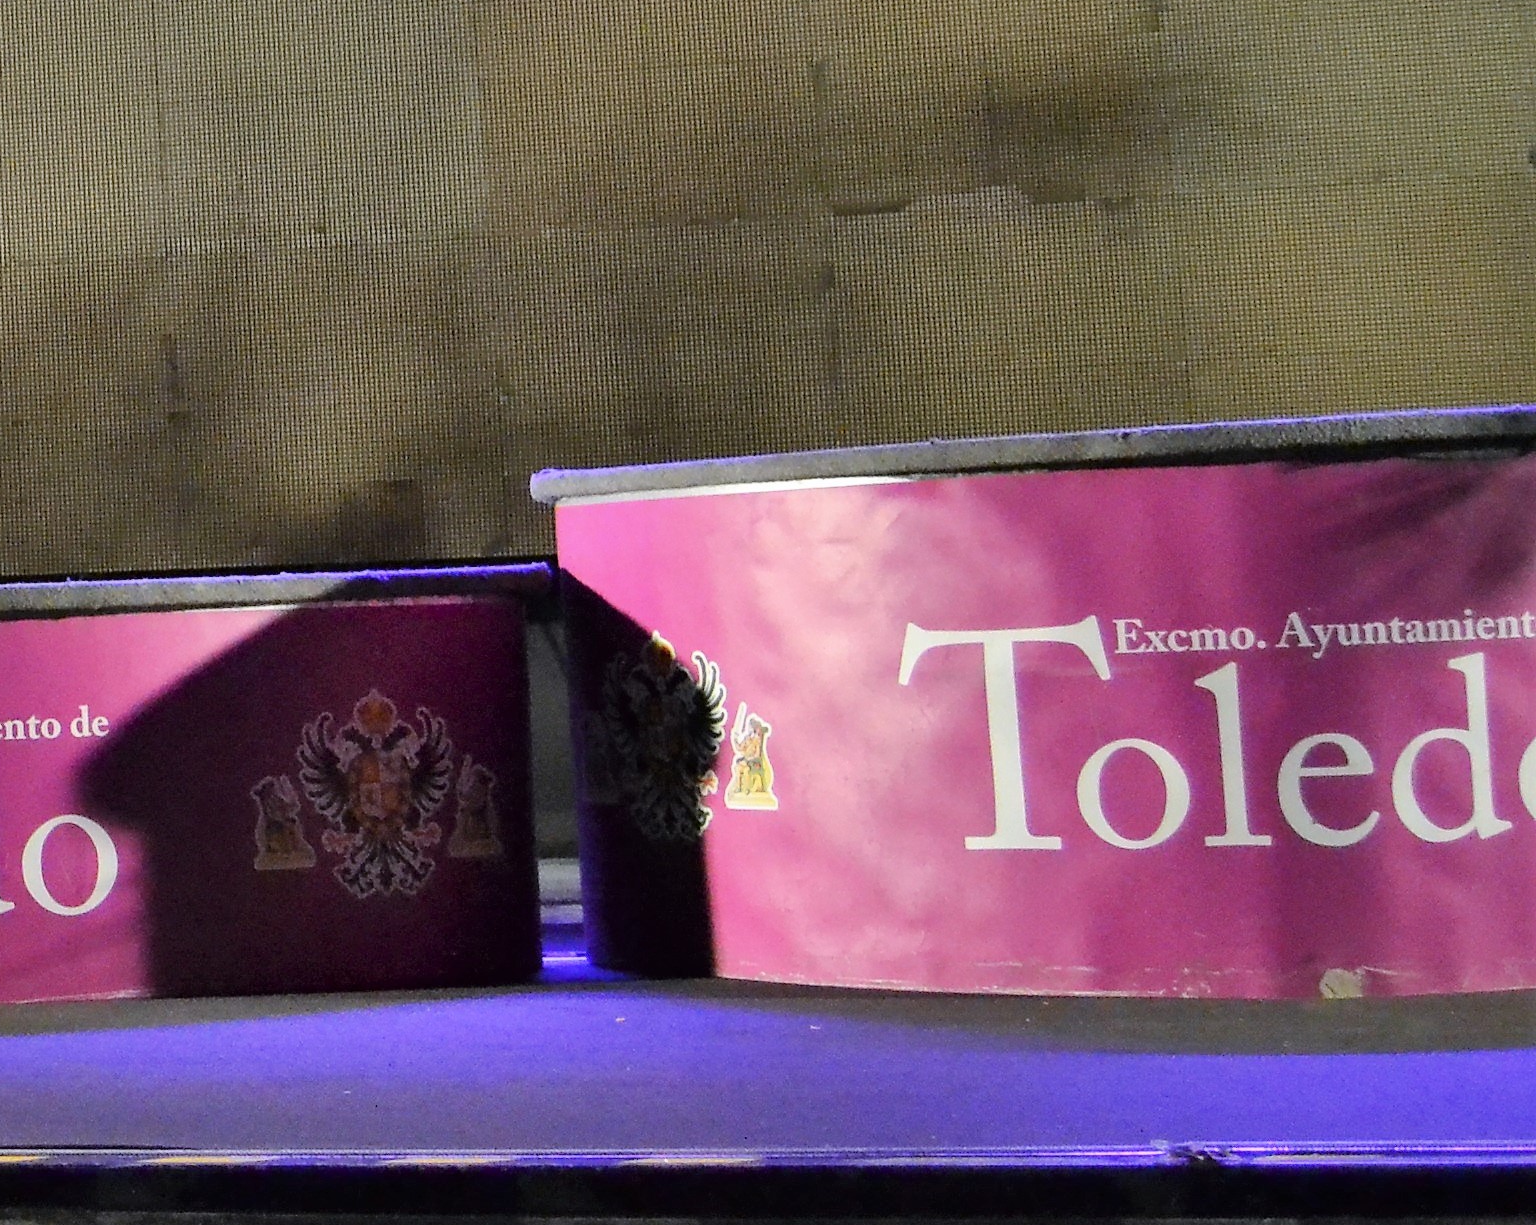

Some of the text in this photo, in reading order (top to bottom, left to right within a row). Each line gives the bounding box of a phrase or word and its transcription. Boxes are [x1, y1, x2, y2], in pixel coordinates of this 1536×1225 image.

[1111, 609, 1536, 660] Excmo. Ayuntamient
[69, 704, 110, 738] de
[897, 614, 1536, 853] Toled
